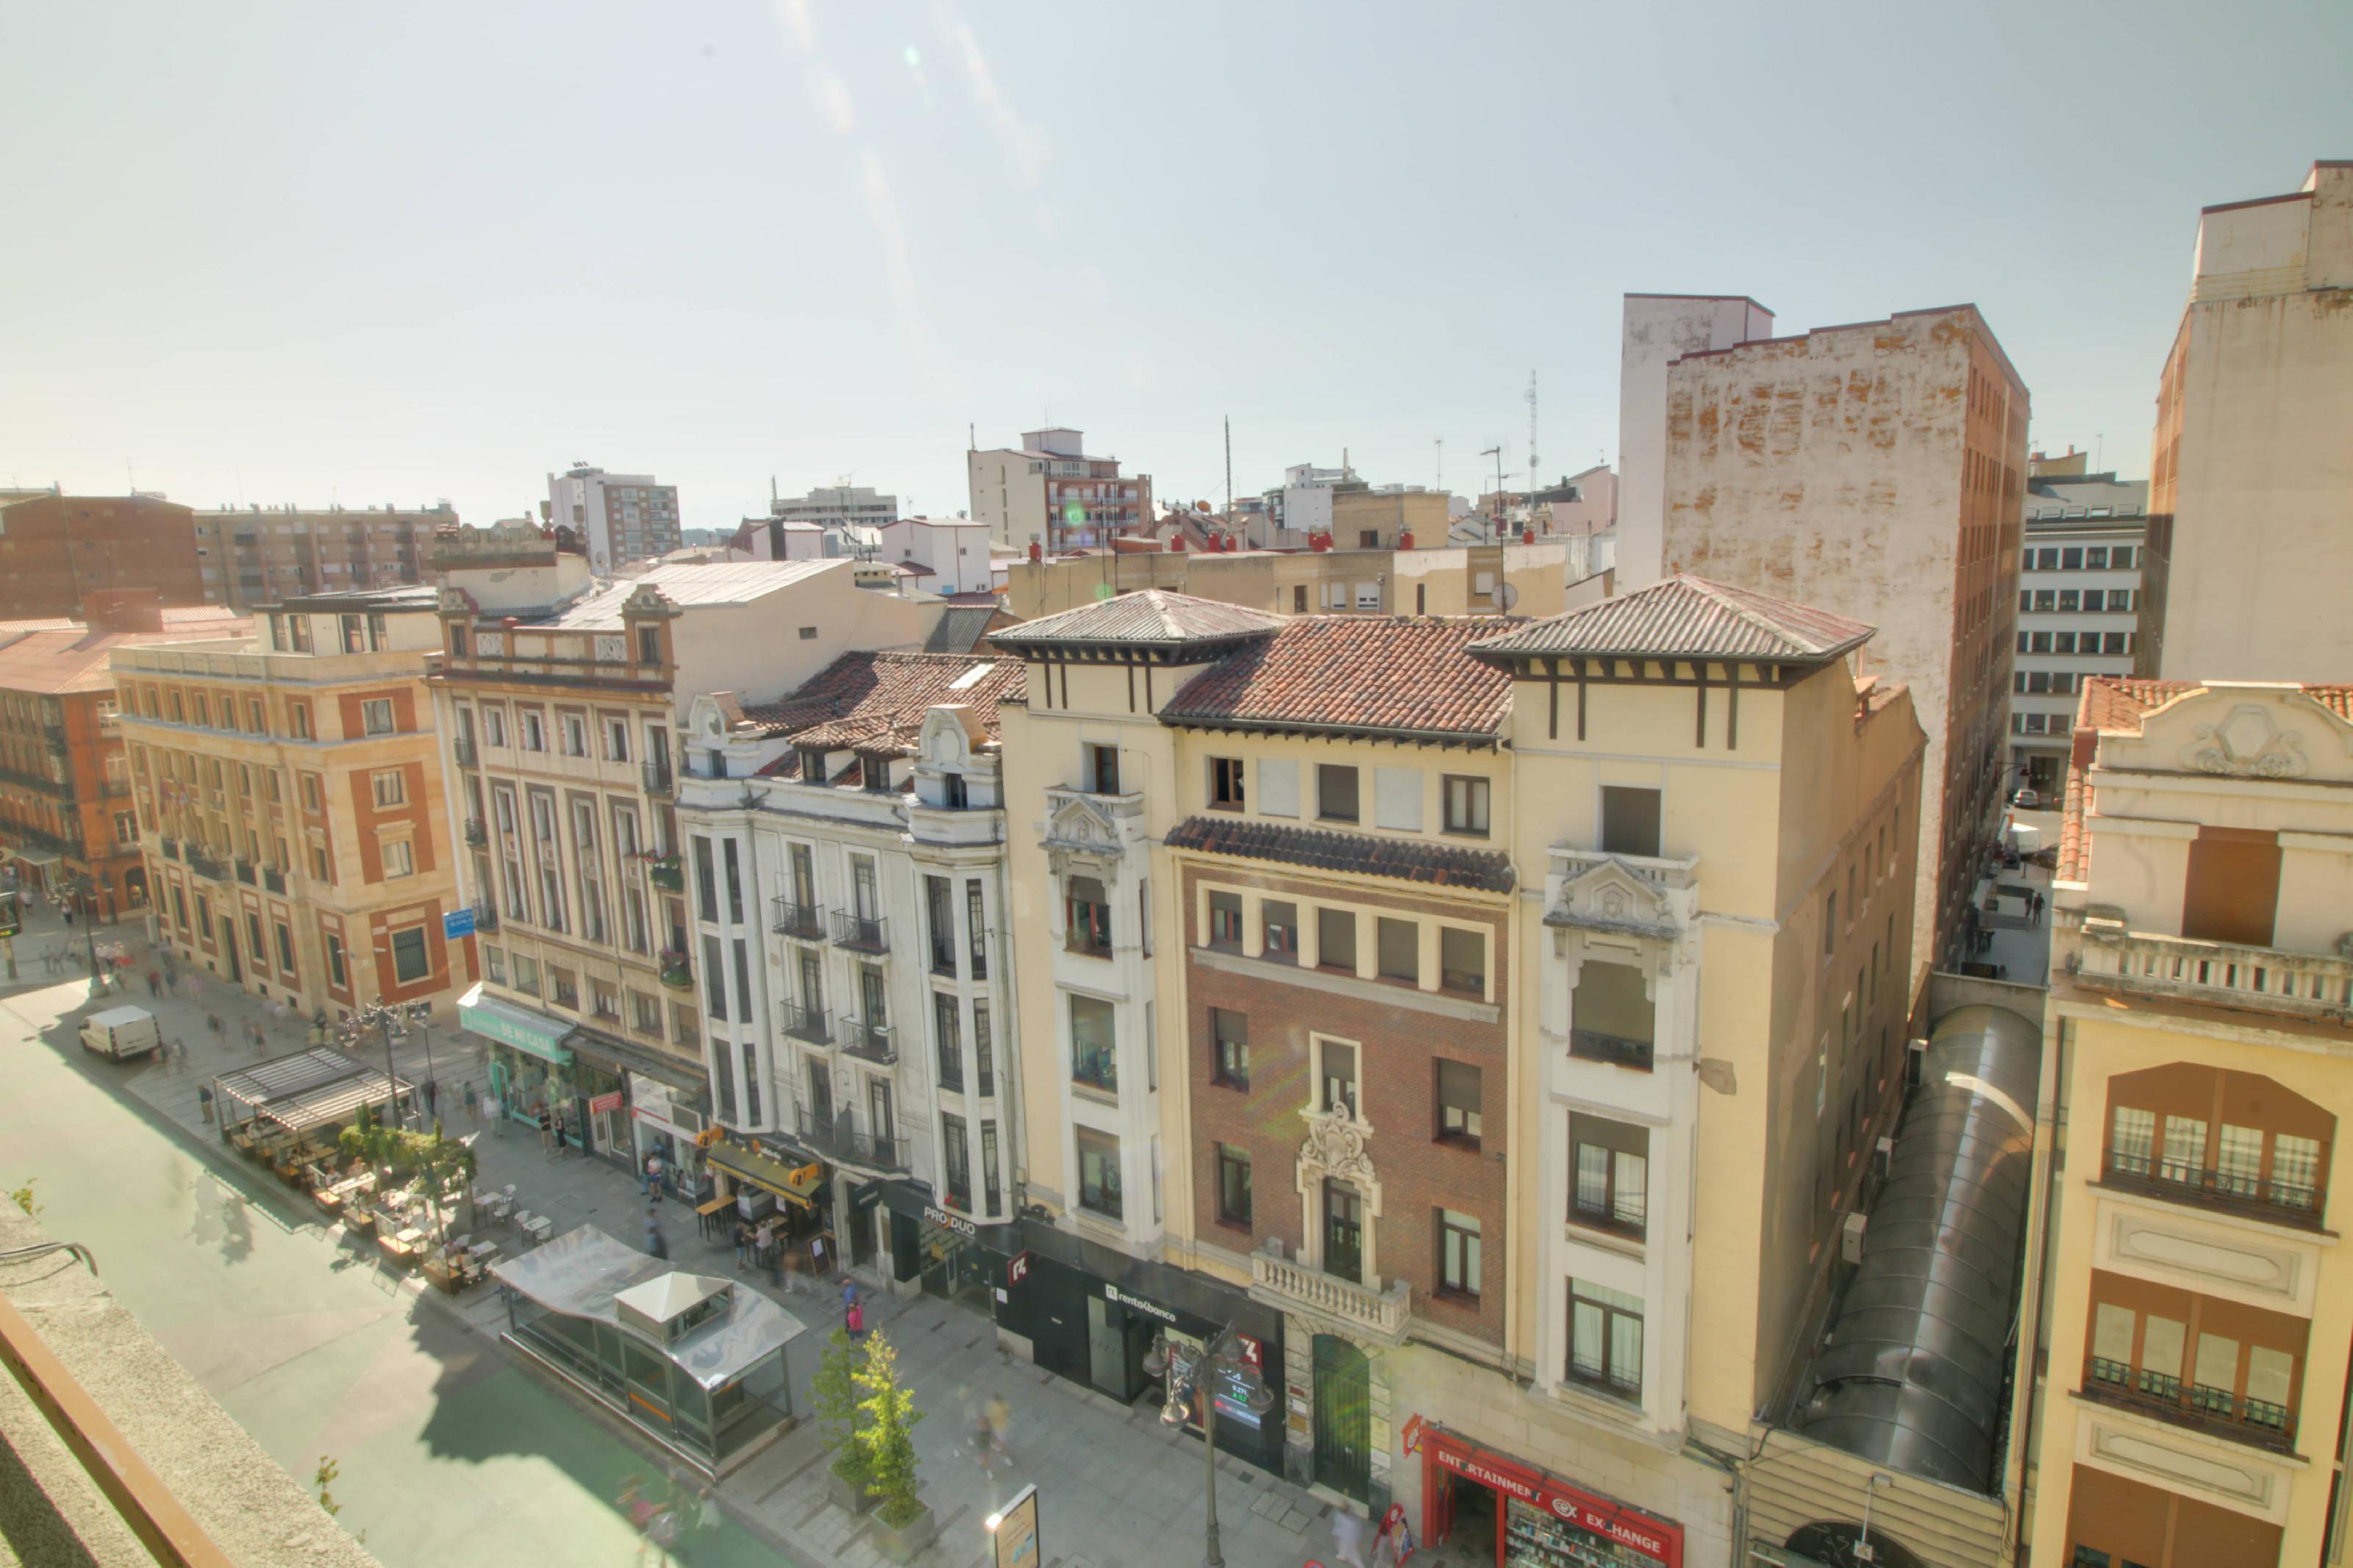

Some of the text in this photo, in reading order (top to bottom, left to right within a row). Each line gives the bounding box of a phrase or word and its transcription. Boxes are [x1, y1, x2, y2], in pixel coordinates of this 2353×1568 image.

[501, 1023, 514, 1039] DE
[515, 1029, 526, 1044] MI
[527, 1032, 551, 1052] CASA
[1118, 1294, 1176, 1322] renta4banco
[1438, 1450, 1542, 1503] ENTRTAINMENT
